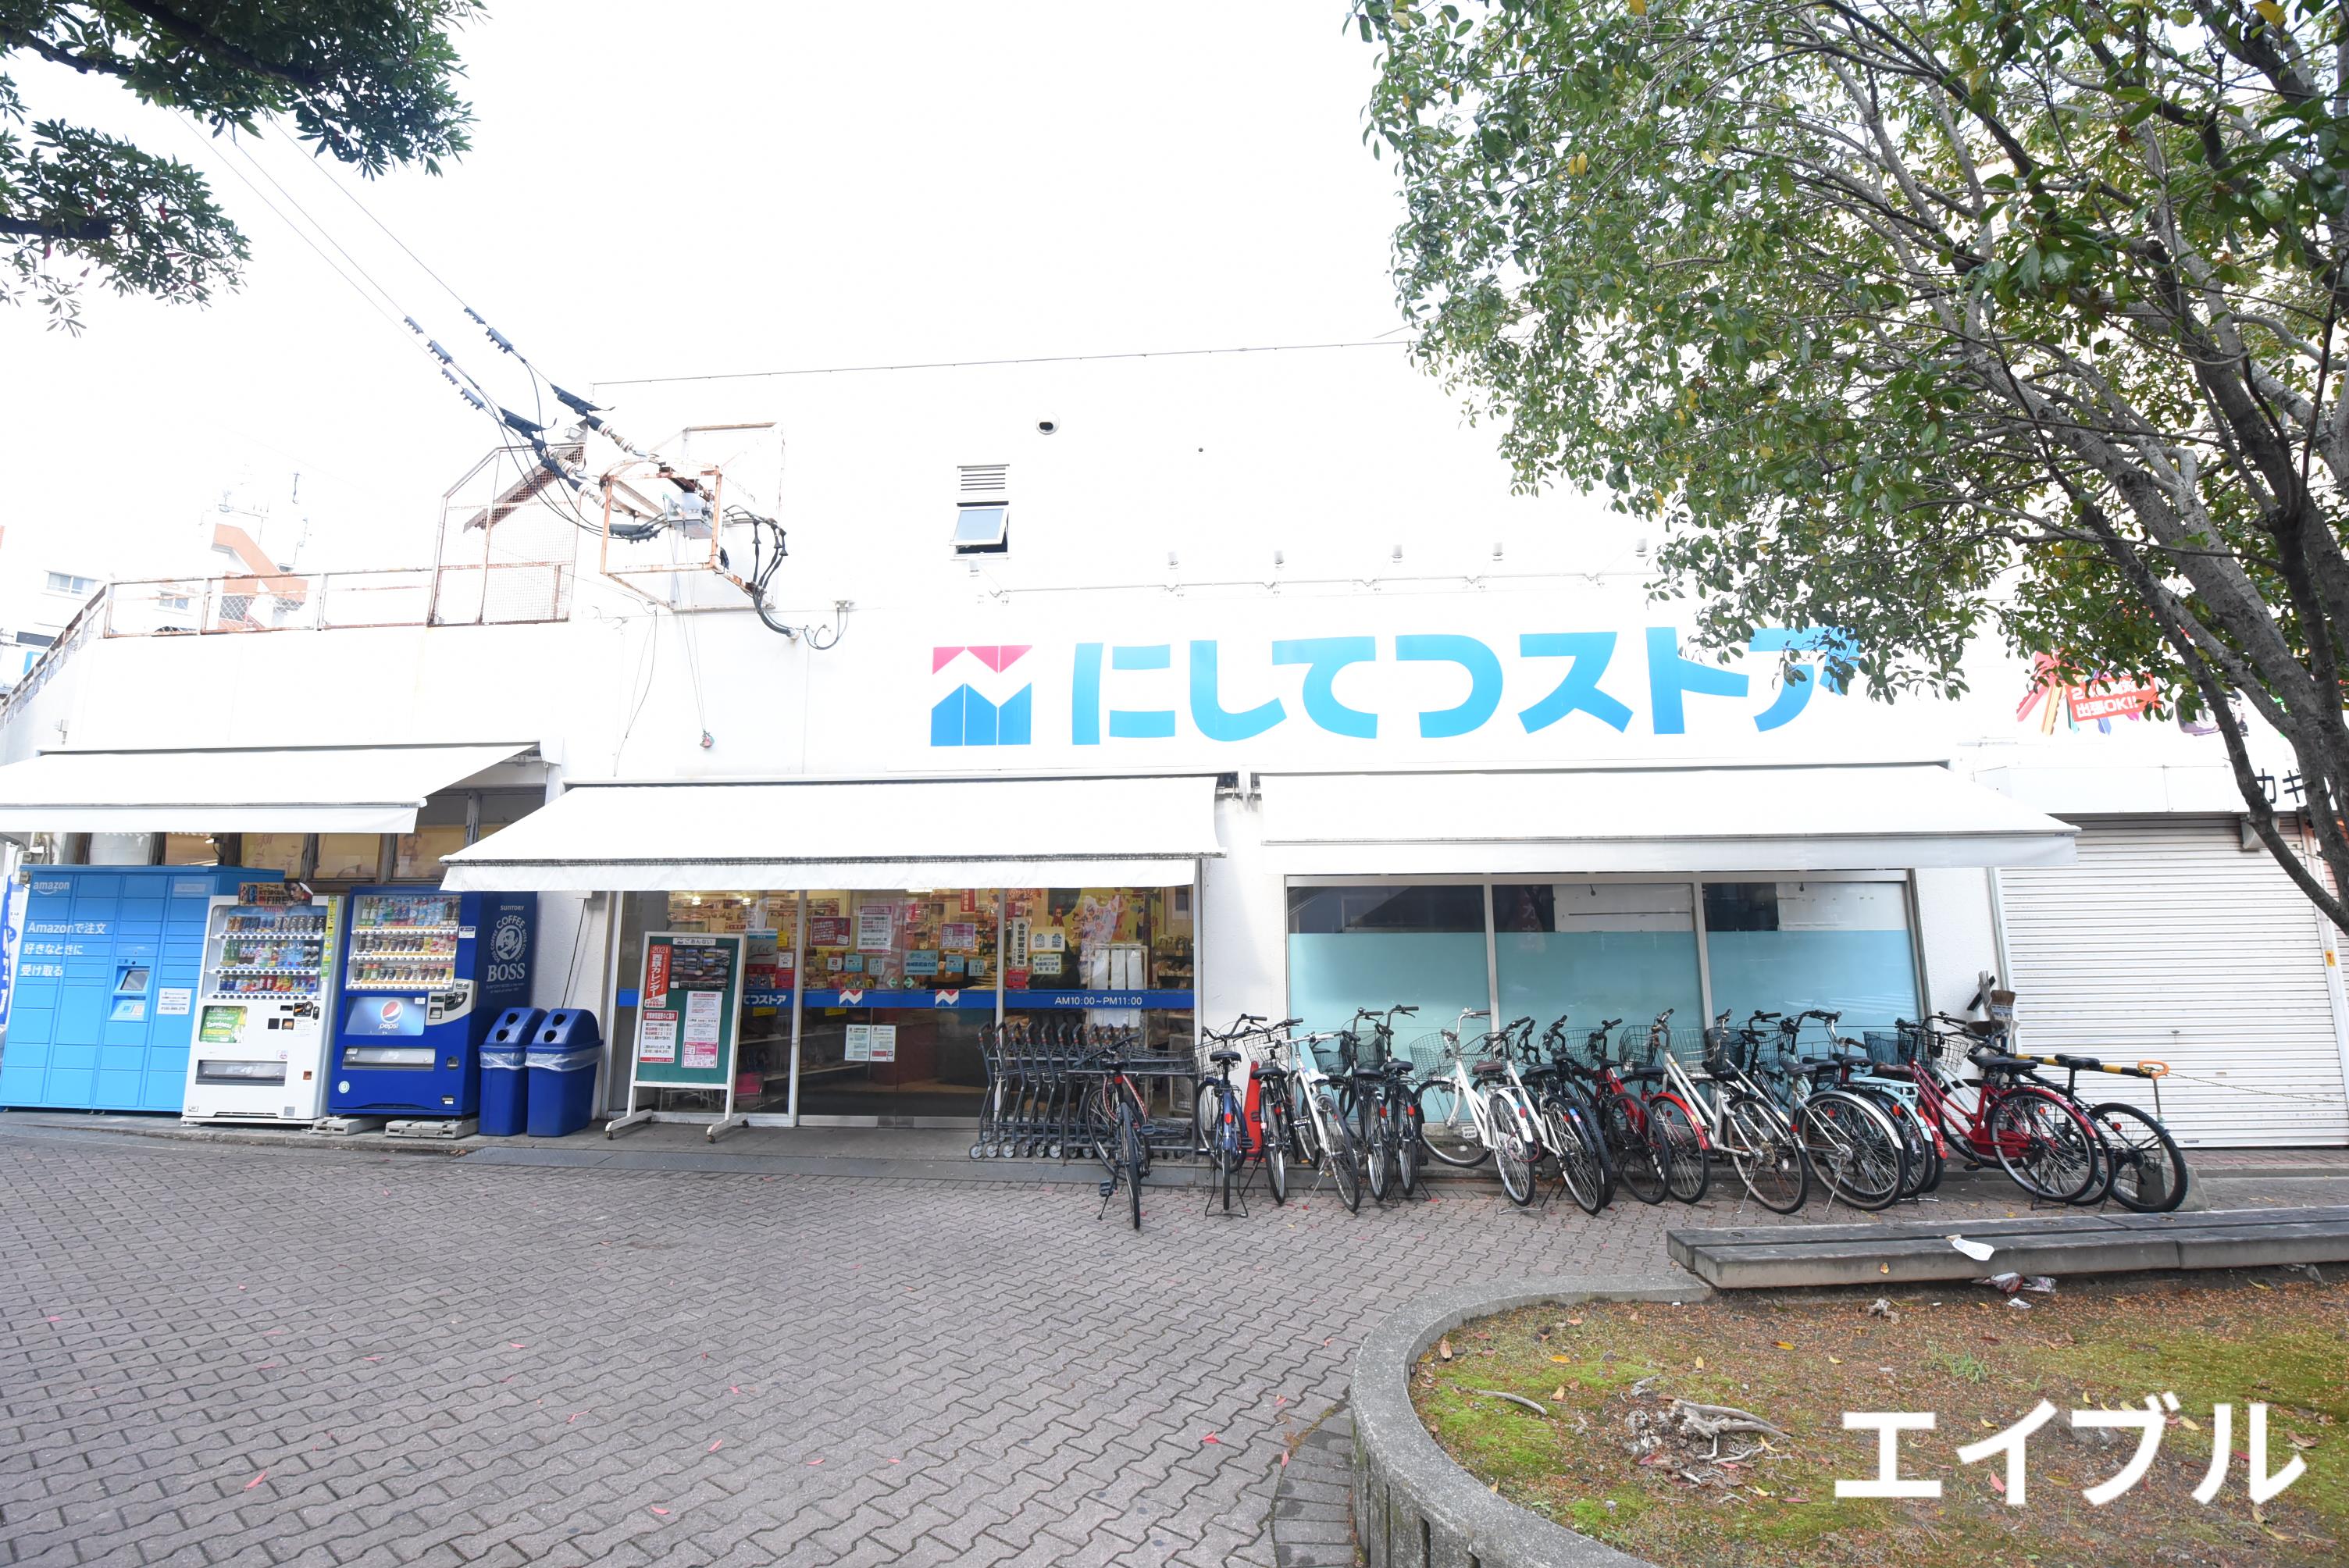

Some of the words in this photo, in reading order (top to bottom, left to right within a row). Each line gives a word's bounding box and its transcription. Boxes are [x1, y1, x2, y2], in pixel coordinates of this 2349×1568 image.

[1071, 625, 1862, 743] にしてつストア
[33, 881, 70, 891] amazon
[266, 896, 288, 905] FIRE
[27, 921, 107, 935] Amazonで注文
[496, 914, 526, 929] COFFEE
[23, 943, 84, 955] 好きなときに
[20, 964, 63, 977] 受け取る
[487, 962, 526, 982] BOSS
